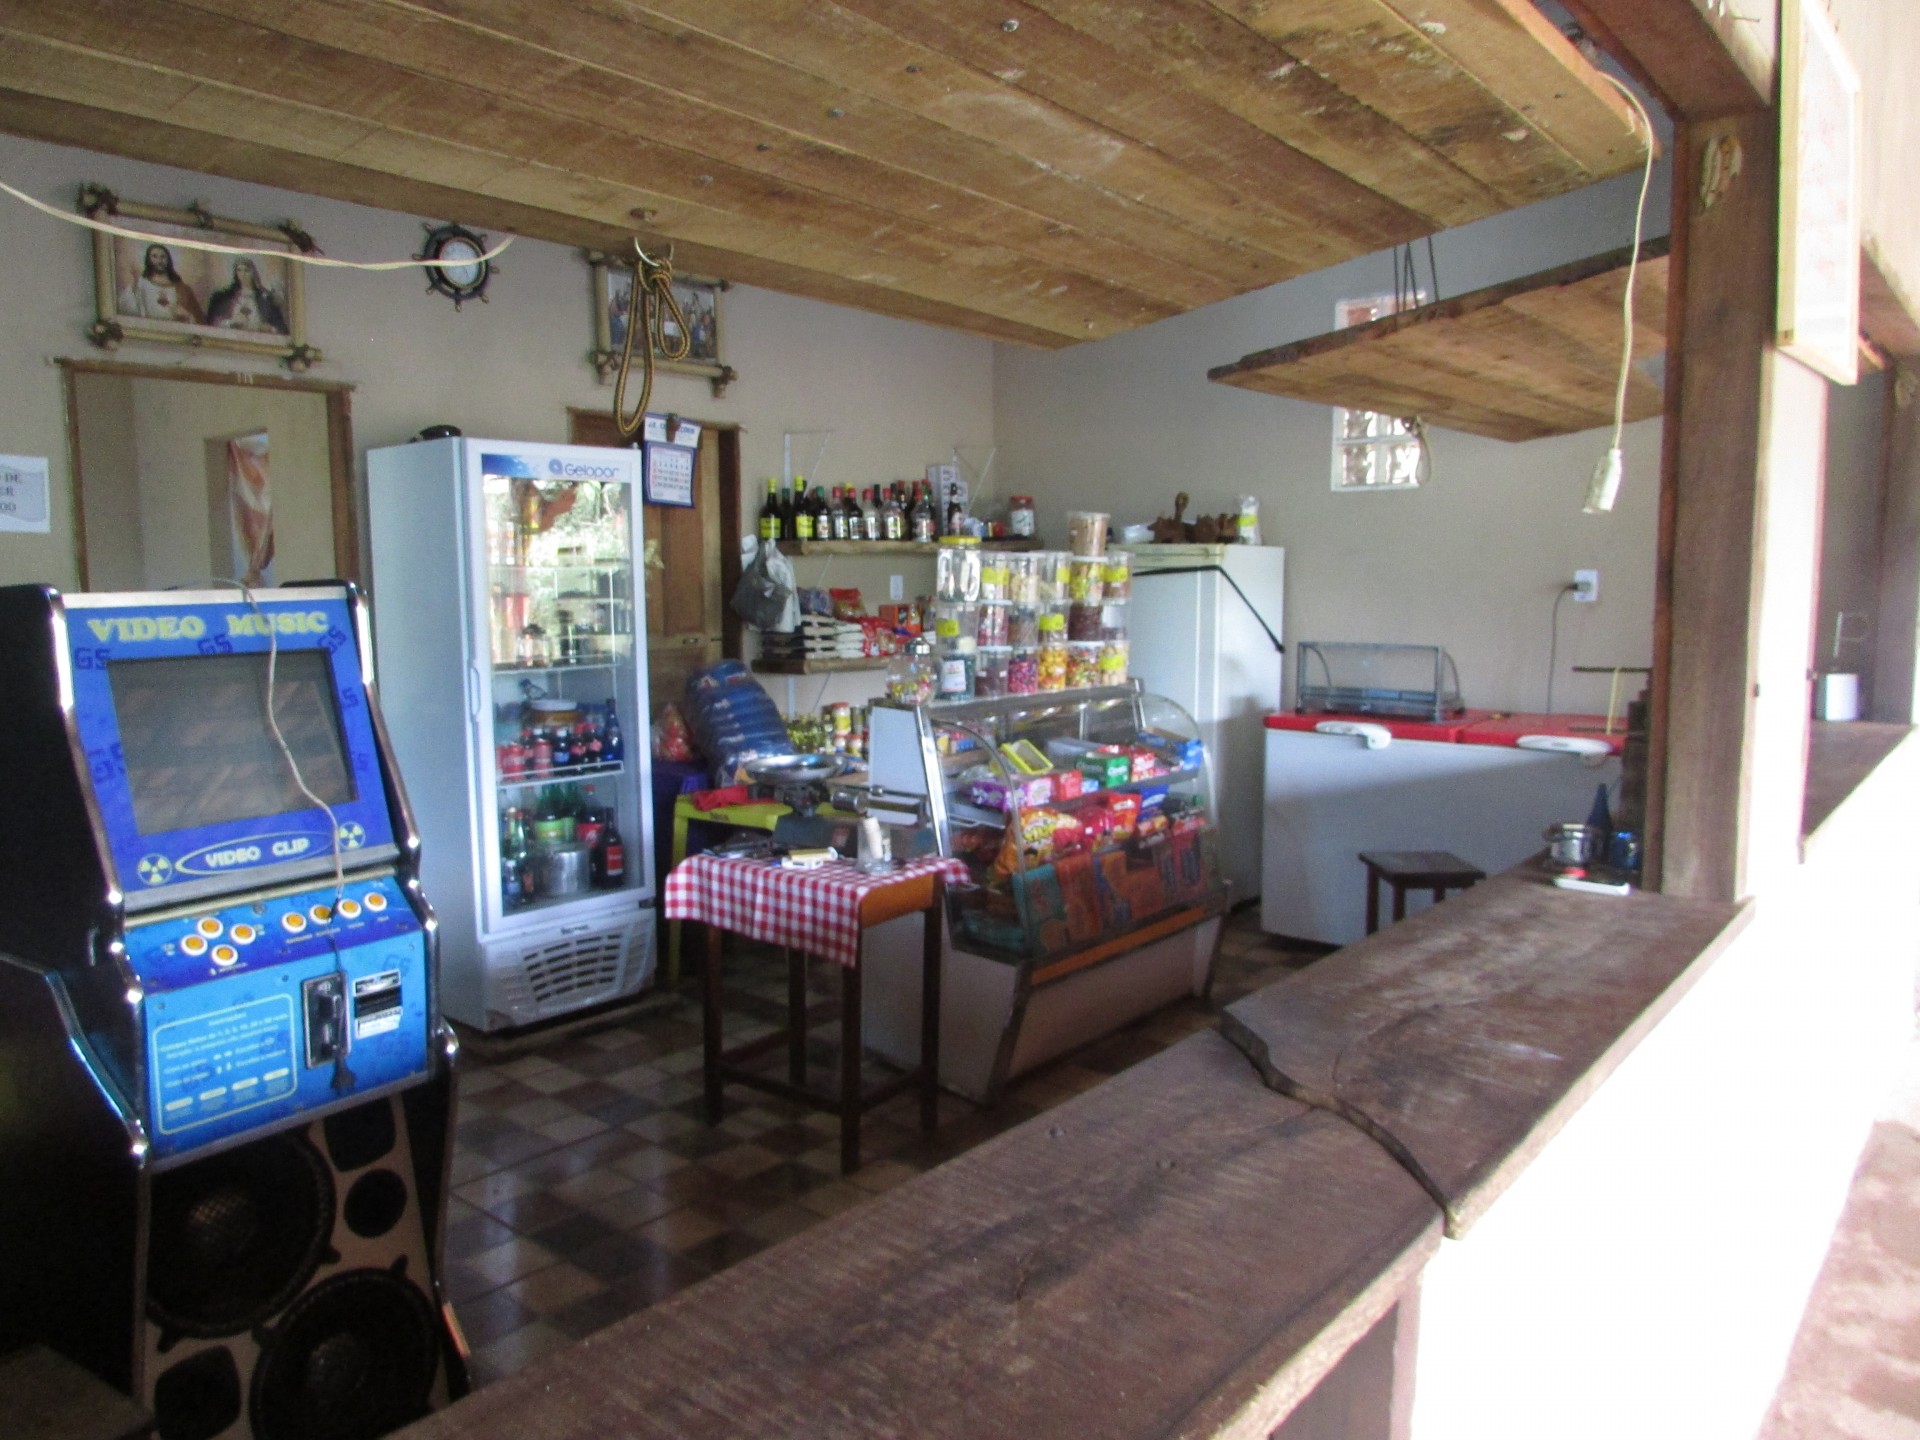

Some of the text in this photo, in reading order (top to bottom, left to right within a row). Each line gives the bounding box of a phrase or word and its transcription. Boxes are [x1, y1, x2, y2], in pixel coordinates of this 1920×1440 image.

[88, 611, 328, 644] VIDEO MUSIC
[204, 837, 311, 869] VIDEO CLIP
